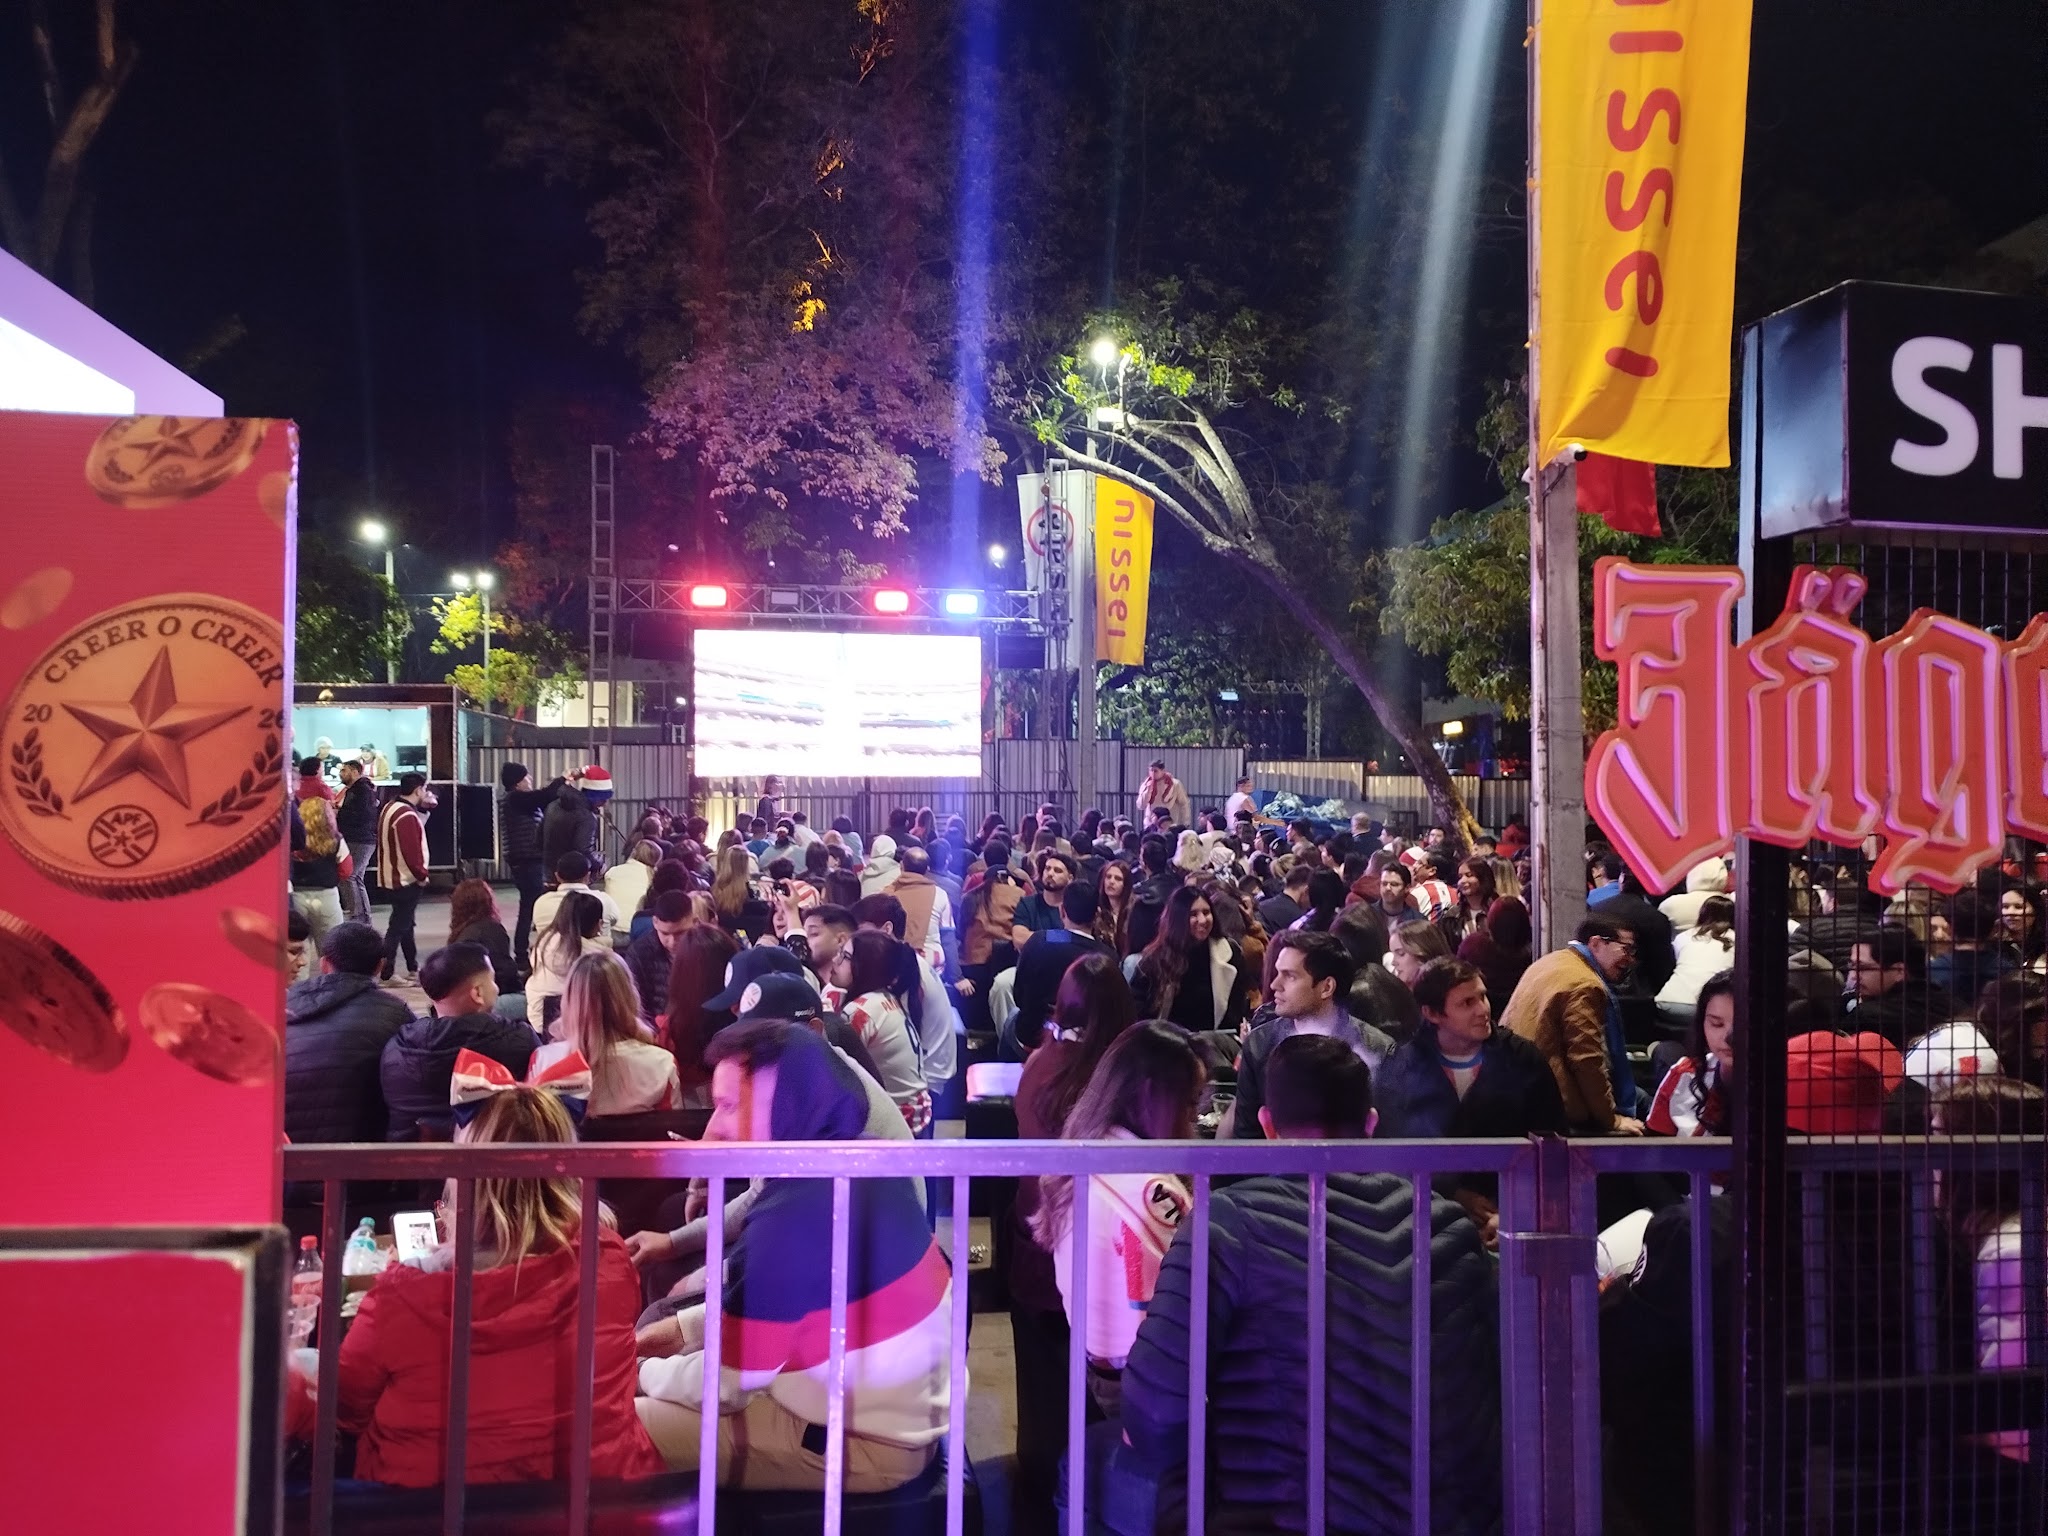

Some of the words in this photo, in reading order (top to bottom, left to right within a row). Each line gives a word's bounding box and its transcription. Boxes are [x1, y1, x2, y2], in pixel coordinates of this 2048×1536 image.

[44, 619, 148, 684] CREER
[158, 615, 182, 636] O
[191, 618, 284, 689] CREER
[22, 704, 53, 723] 20
